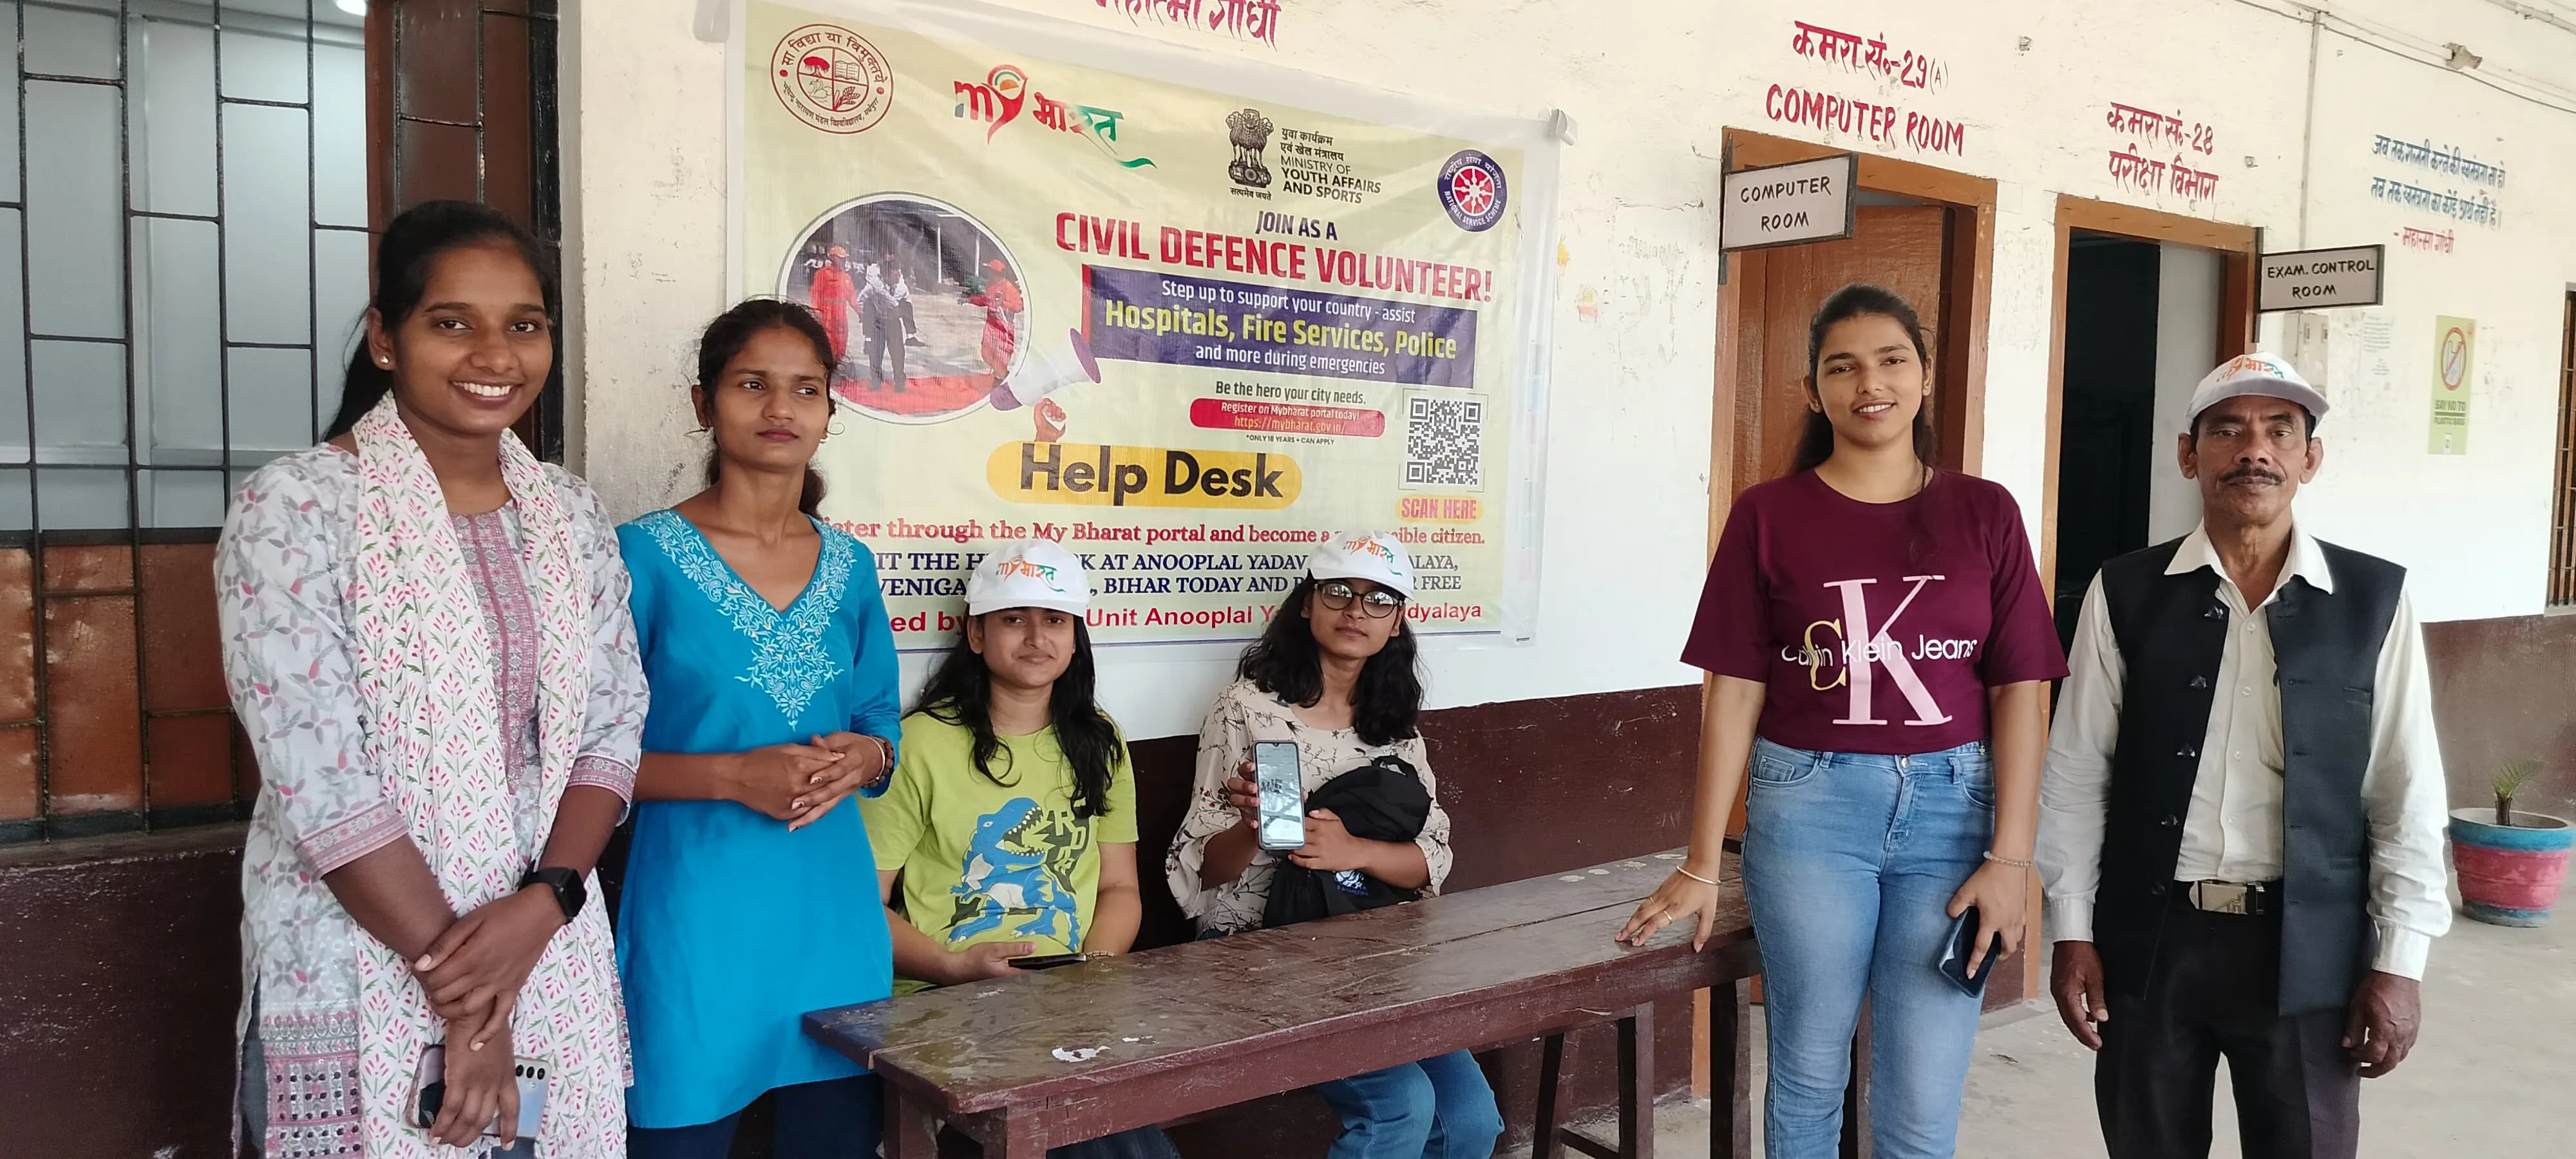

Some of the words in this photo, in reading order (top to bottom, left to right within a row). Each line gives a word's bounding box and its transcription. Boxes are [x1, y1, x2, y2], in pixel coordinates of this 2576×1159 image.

[825, 32, 842, 44] या
[1793, 20, 1862, 73] कमरा
[1766, 84, 1897, 149] COMPUTER
[1906, 111, 1964, 156] ROOM
[2107, 102, 2163, 149] कमरा
[1281, 127, 1298, 140] युवा
[1300, 131, 1333, 146] कार्यक्रम
[1280, 142, 1293, 154] एवं
[1295, 142, 1312, 156] खेल
[1314, 147, 1344, 162] मंत्रालय
[1281, 155, 1333, 173] MINISTRY
[1336, 164, 1351, 175] OF
[2108, 143, 2166, 193] परीक्षा
[2170, 155, 2219, 203] विभाग
[1282, 167, 1328, 185] YOUTH
[1332, 175, 1381, 194] AFFAIRS
[1741, 175, 1832, 203] COMPUTER
[1256, 191, 1271, 202] जयते
[1283, 181, 1312, 196] AND
[1316, 185, 1362, 204] SPORTS
[1444, 191, 1462, 220] NATIONAL
[1463, 216, 1486, 227] SERVICE
[1486, 198, 1501, 223] SCHEME
[1255, 211, 1294, 236] JOIN
[1298, 218, 1320, 239] AS
[1326, 221, 1338, 241] A
[1761, 211, 1810, 232] ROOM
[1056, 212, 1150, 261] CIVIL
[1160, 226, 1306, 280] DEFENCE
[1315, 247, 1492, 303] VOLUNTEER!
[2268, 265, 2309, 278] EXAM.
[2311, 259, 2375, 275] CONTROL
[1162, 280, 1194, 301] Step
[1199, 286, 1216, 303] up
[1220, 287, 1233, 303] to
[1238, 290, 1289, 310] support
[1293, 297, 1322, 314] your
[1326, 300, 1371, 321] country
[1383, 307, 1416, 324] assist
[2292, 285, 2337, 299] ROOM
[1105, 299, 1235, 343] Hospitals,
[1242, 313, 1287, 343] Fire
[1293, 319, 1389, 357] Services,
[1395, 330, 1457, 359] Police
[1196, 344, 1222, 360] and
[1226, 351, 1260, 364] more
[1264, 349, 1306, 370] during
[1310, 355, 1385, 375] emergencies
[1215, 381, 1231, 395] Be
[1234, 382, 1253, 396] the
[1256, 383, 1281, 398] hero
[1285, 388, 1309, 401] your
[1311, 388, 1331, 404] city
[1333, 391, 1367, 405] needs.
[1221, 402, 1257, 415] Register
[1258, 406, 1269, 415] on
[1271, 405, 1309, 417] Mybharat
[1311, 408, 1334, 419] portal
[2435, 399, 2447, 410] SAY
[2448, 400, 2457, 411] NO
[2458, 401, 2467, 411] TO
[1316, 437, 1334, 446] APPLY
[1020, 442, 1148, 507] Help
[1164, 450, 1285, 498] Desk
[1401, 498, 1439, 520] SCAN
[1443, 498, 1477, 520] HERE
[887, 518, 985, 543] through
[990, 520, 1027, 540] the
[1032, 522, 1068, 543] My
[1072, 522, 1141, 542] Bharat
[1146, 523, 1206, 545] portal
[1210, 524, 1244, 543] and
[1249, 525, 1317, 543] become
[1320, 530, 1330, 543] a
[1430, 527, 1485, 545] citizen.
[907, 553, 960, 570] THE
[1097, 554, 1128, 570] AT
[1132, 554, 1243, 570] ANOOPLAL
[1247, 554, 1309, 570] YADAV
[1103, 577, 1171, 594] BIHAR
[1177, 577, 1244, 593] TODAY
[1246, 576, 1288, 592] AND
[1422, 576, 1461, 590] FREE
[1086, 608, 1138, 627] Unit
[1144, 606, 1252, 628] Anooplal
[1911, 634, 1977, 660] Jeans
